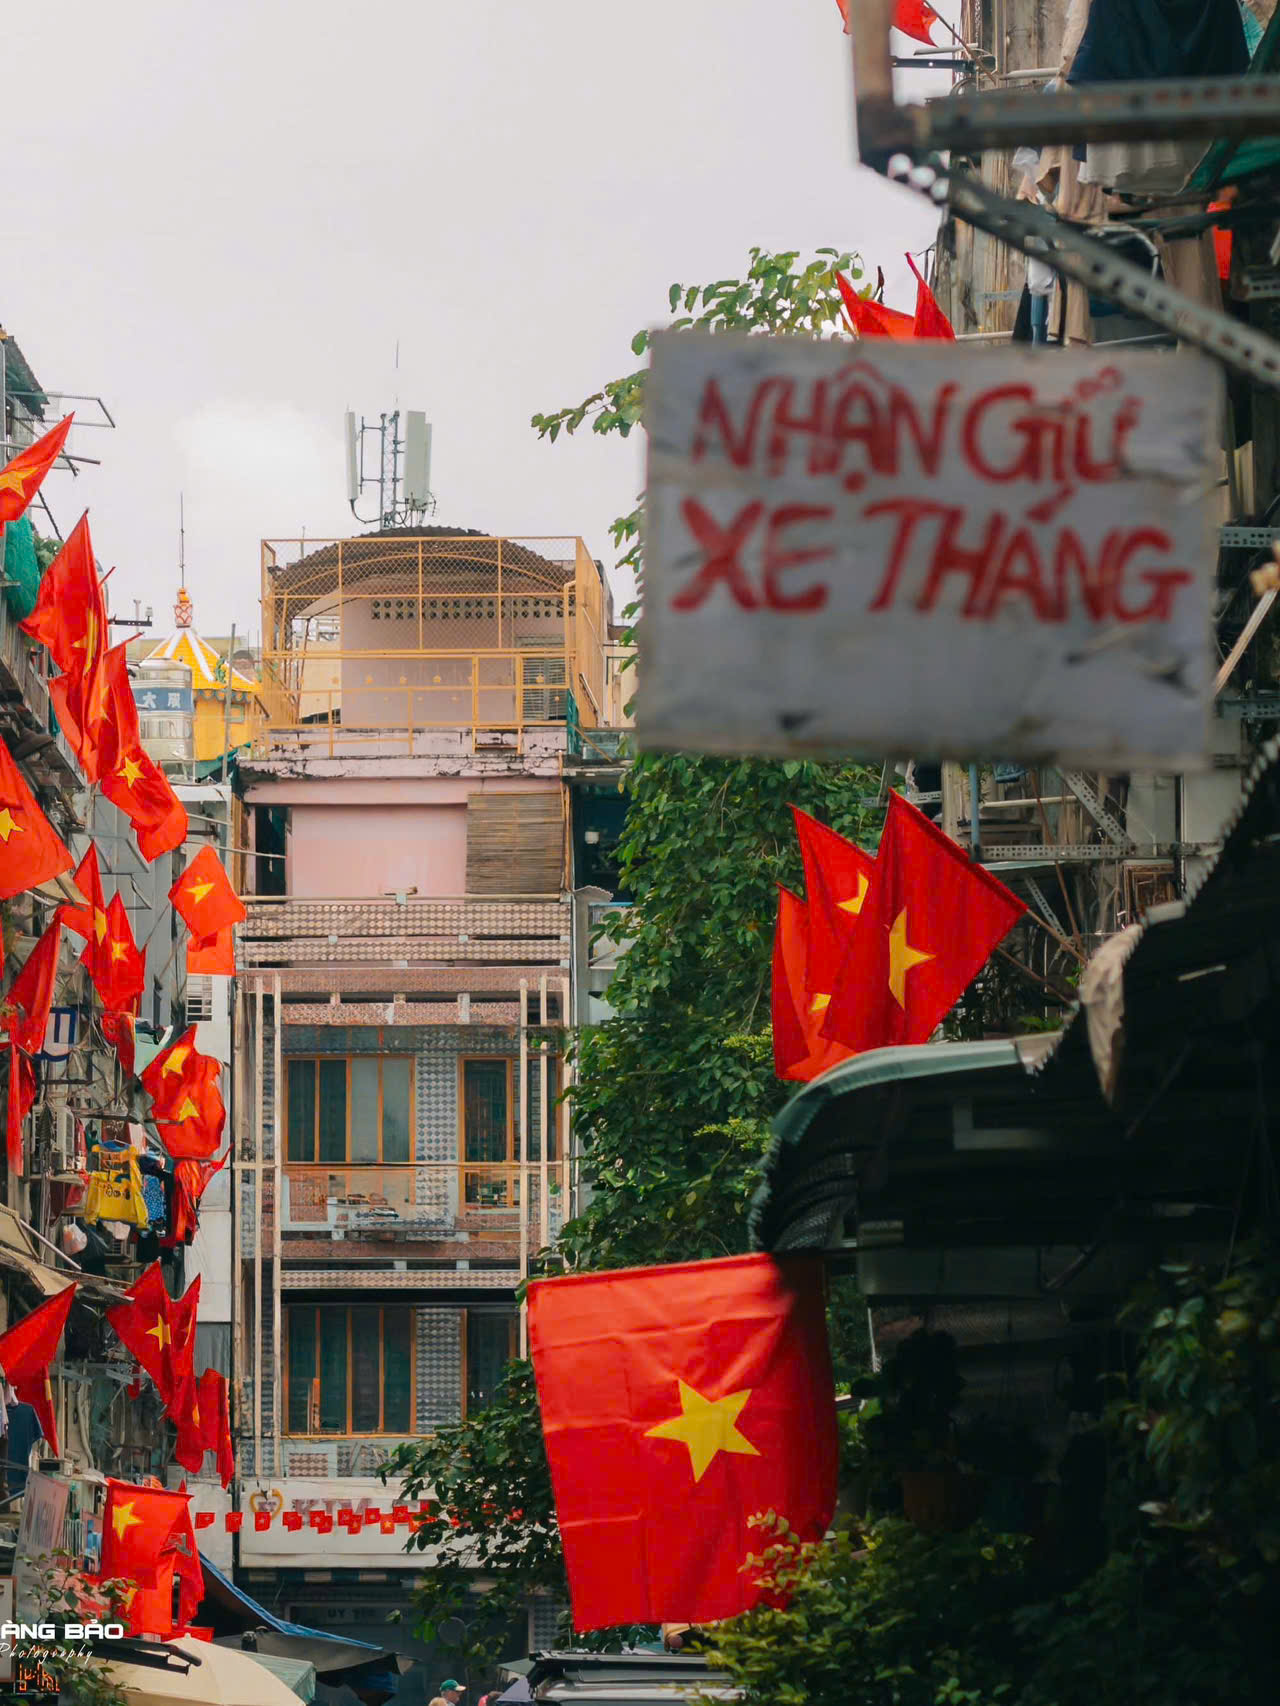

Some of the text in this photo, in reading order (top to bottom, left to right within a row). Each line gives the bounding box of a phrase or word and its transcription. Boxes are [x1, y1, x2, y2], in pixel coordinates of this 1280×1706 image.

[690, 360, 958, 494] NHẬN
[671, 487, 1193, 624] XE THÁNG
